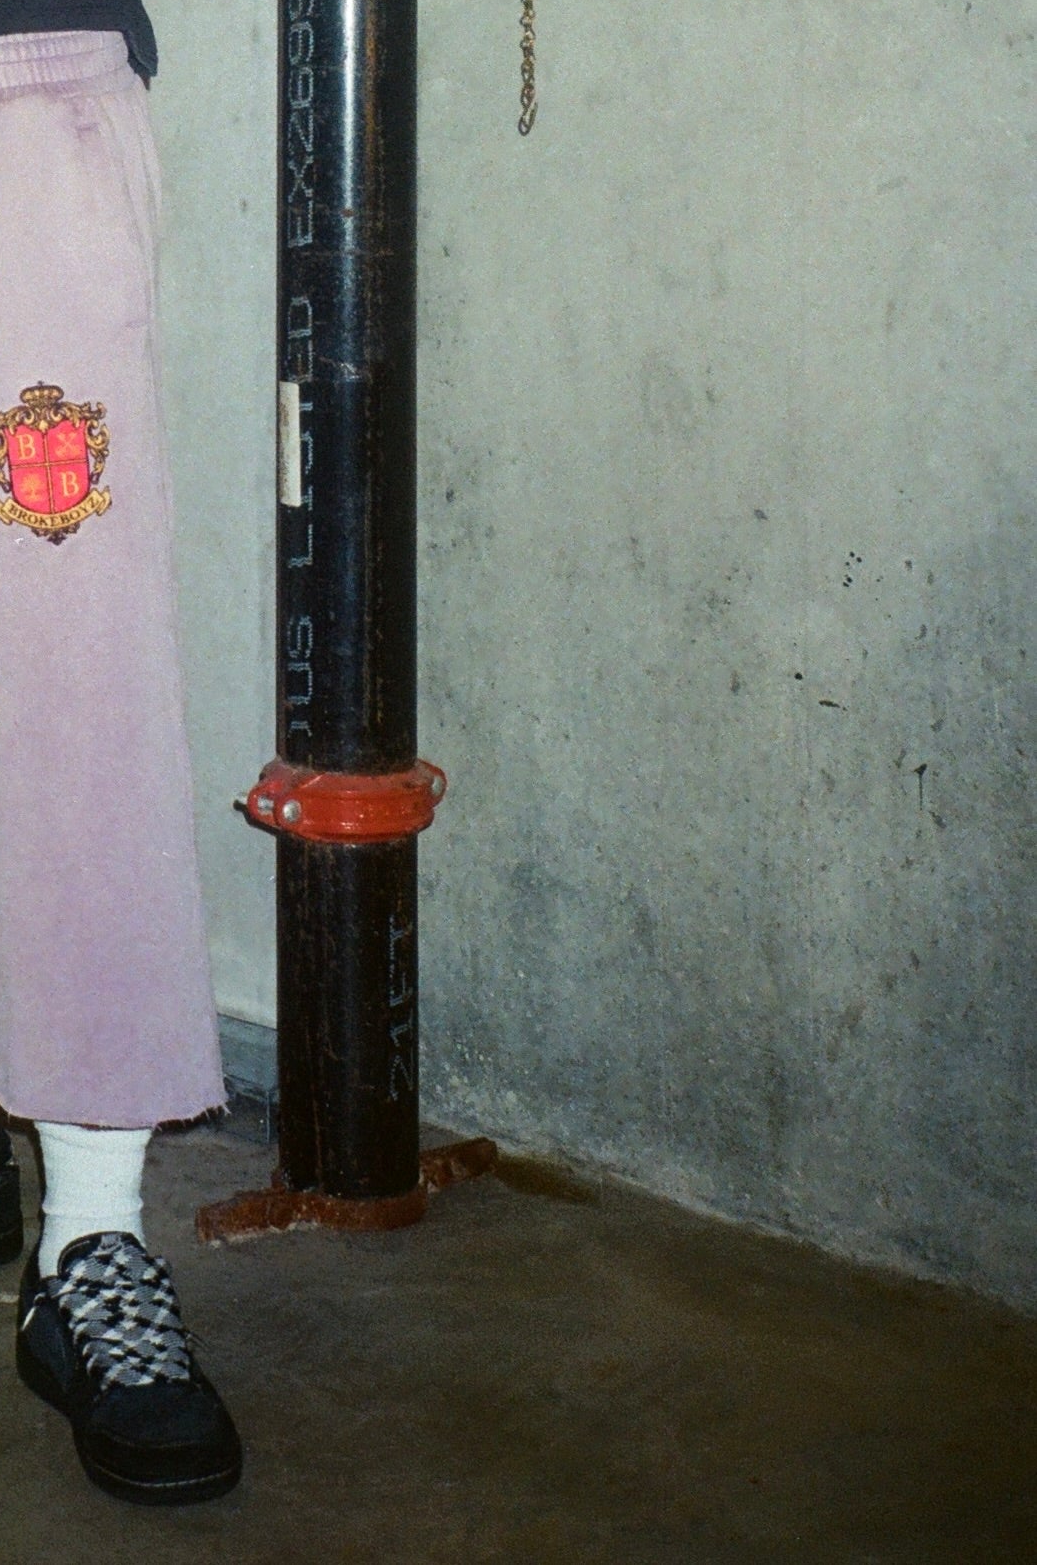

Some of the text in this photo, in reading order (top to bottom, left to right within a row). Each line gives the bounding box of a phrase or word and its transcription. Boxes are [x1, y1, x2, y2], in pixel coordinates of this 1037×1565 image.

[17, 433, 36, 460] B
[61, 470, 80, 497] B
[8, 495, 100, 527] BROKEBOYZ
